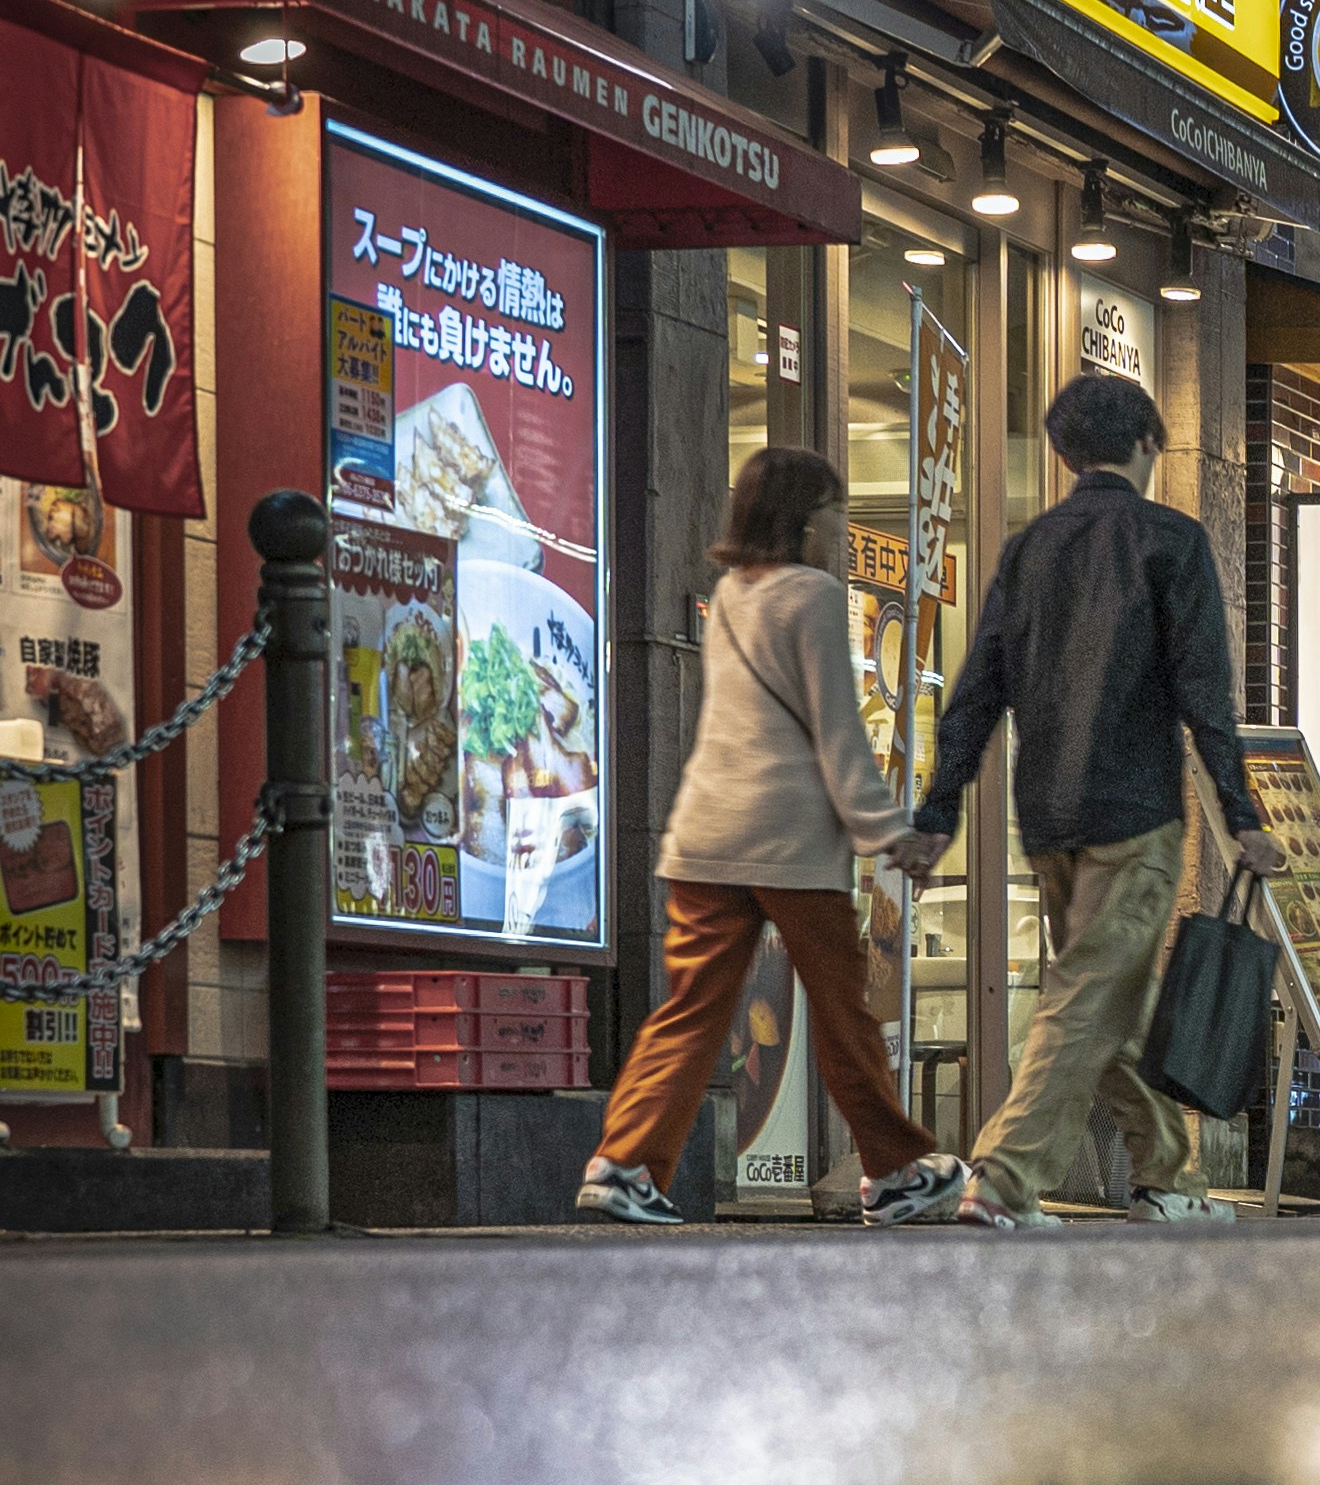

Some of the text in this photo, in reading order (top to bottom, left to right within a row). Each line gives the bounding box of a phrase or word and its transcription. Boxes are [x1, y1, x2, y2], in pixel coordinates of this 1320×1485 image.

[1284, 9, 1310, 72] Good
[511, 36, 629, 117] RAUMEN
[642, 94, 780, 191] GENKOTSU
[1170, 109, 1268, 192] CoCoICHIBANYA
[353, 207, 565, 331] スープにかける情熱は
[1095, 299, 1126, 335] CoCo
[338, 329, 387, 361] アルバイト
[19, 635, 101, 679] 自家製焼豚
[746, 1155, 806, 1184] CoCo壱番屋
